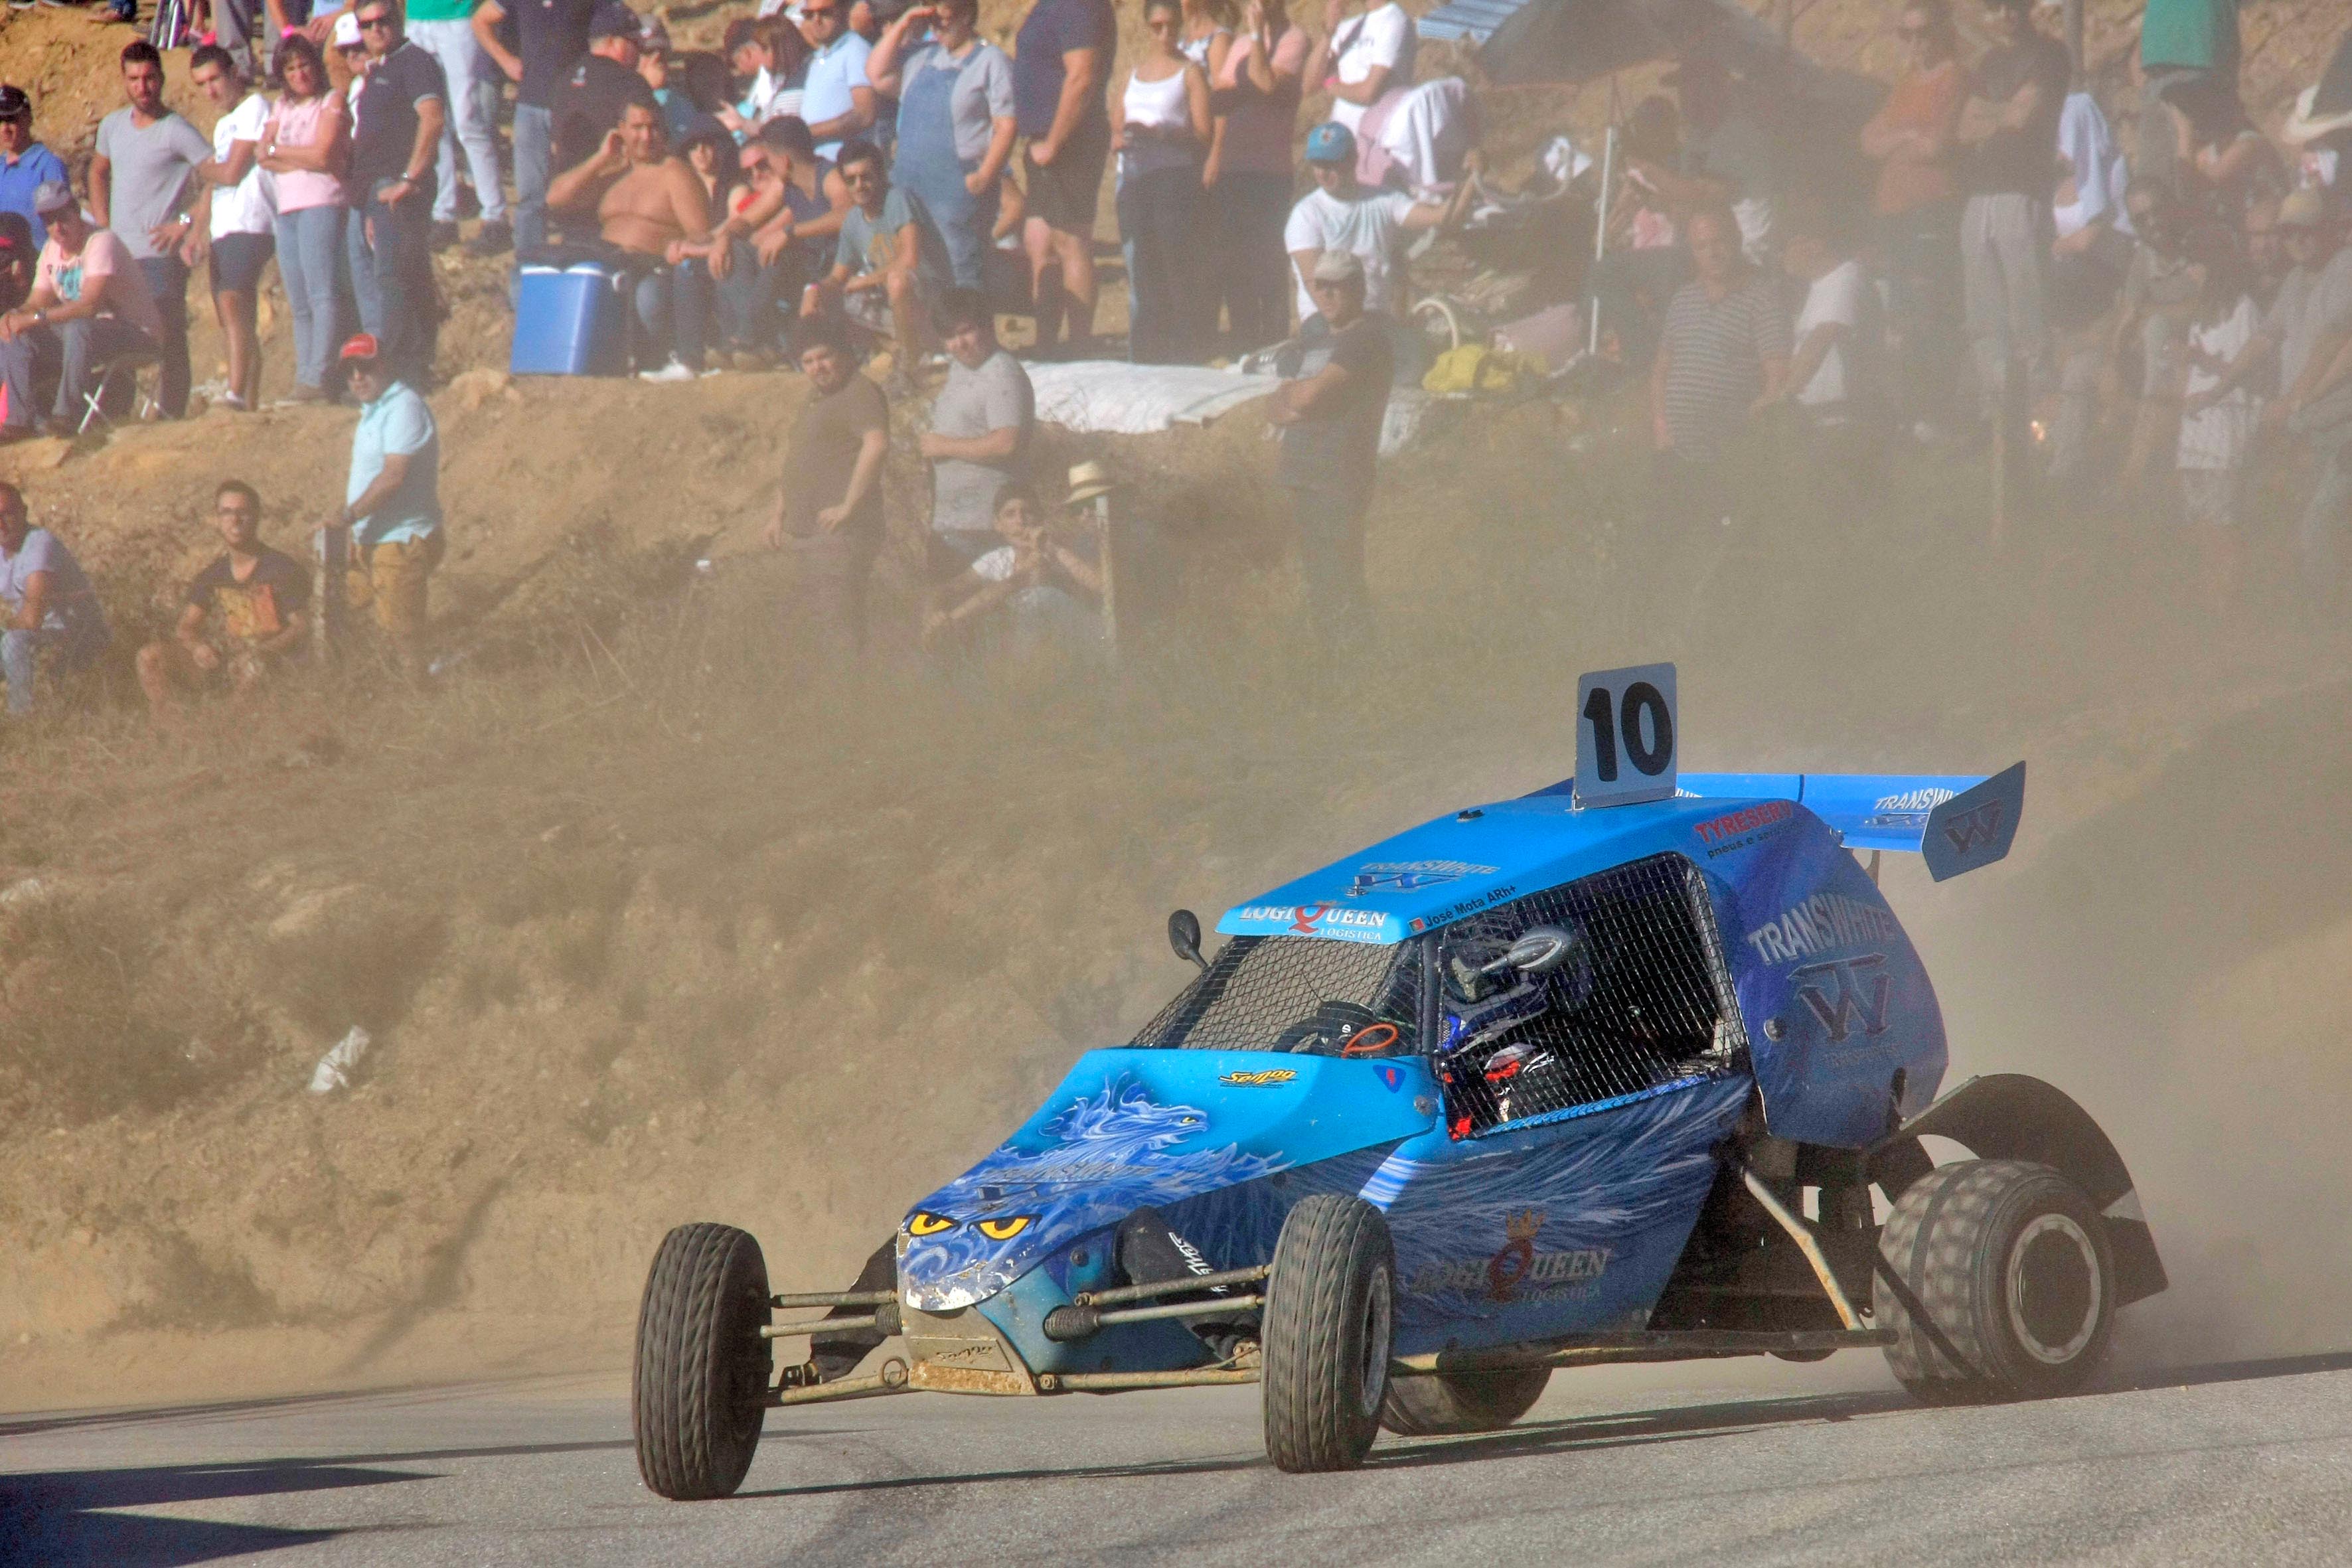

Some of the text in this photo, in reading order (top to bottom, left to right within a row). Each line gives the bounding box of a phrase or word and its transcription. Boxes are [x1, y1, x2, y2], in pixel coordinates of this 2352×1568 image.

[1583, 681, 1673, 782] 10
[1425, 907, 1454, 927] José
[1454, 897, 1486, 914] Mota
